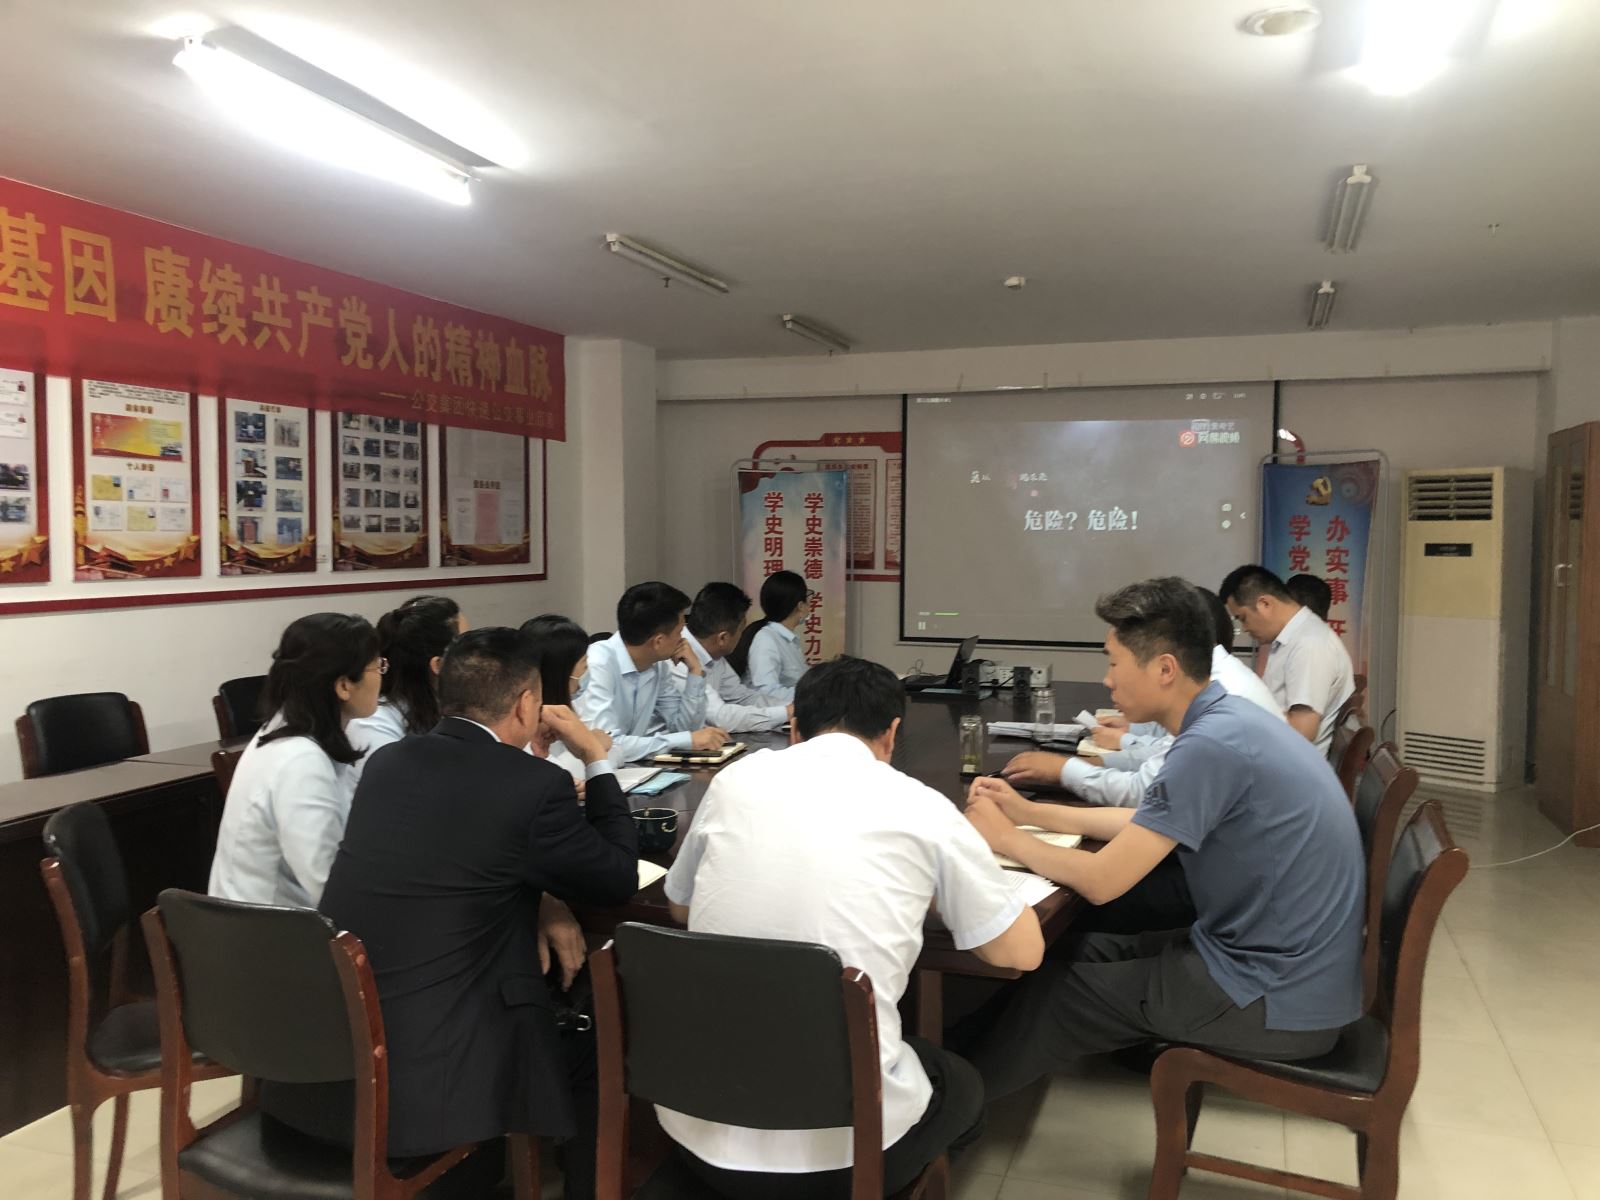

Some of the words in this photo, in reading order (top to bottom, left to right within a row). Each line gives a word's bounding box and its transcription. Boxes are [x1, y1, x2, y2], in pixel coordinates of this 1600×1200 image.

[0, 206, 117, 322] 基因
[144, 245, 552, 402] 赓续共产党人的精神血脉
[763, 491, 784, 577] 学史明理
[804, 492, 824, 579] 学史崇德
[1326, 515, 1350, 605] 办实事
